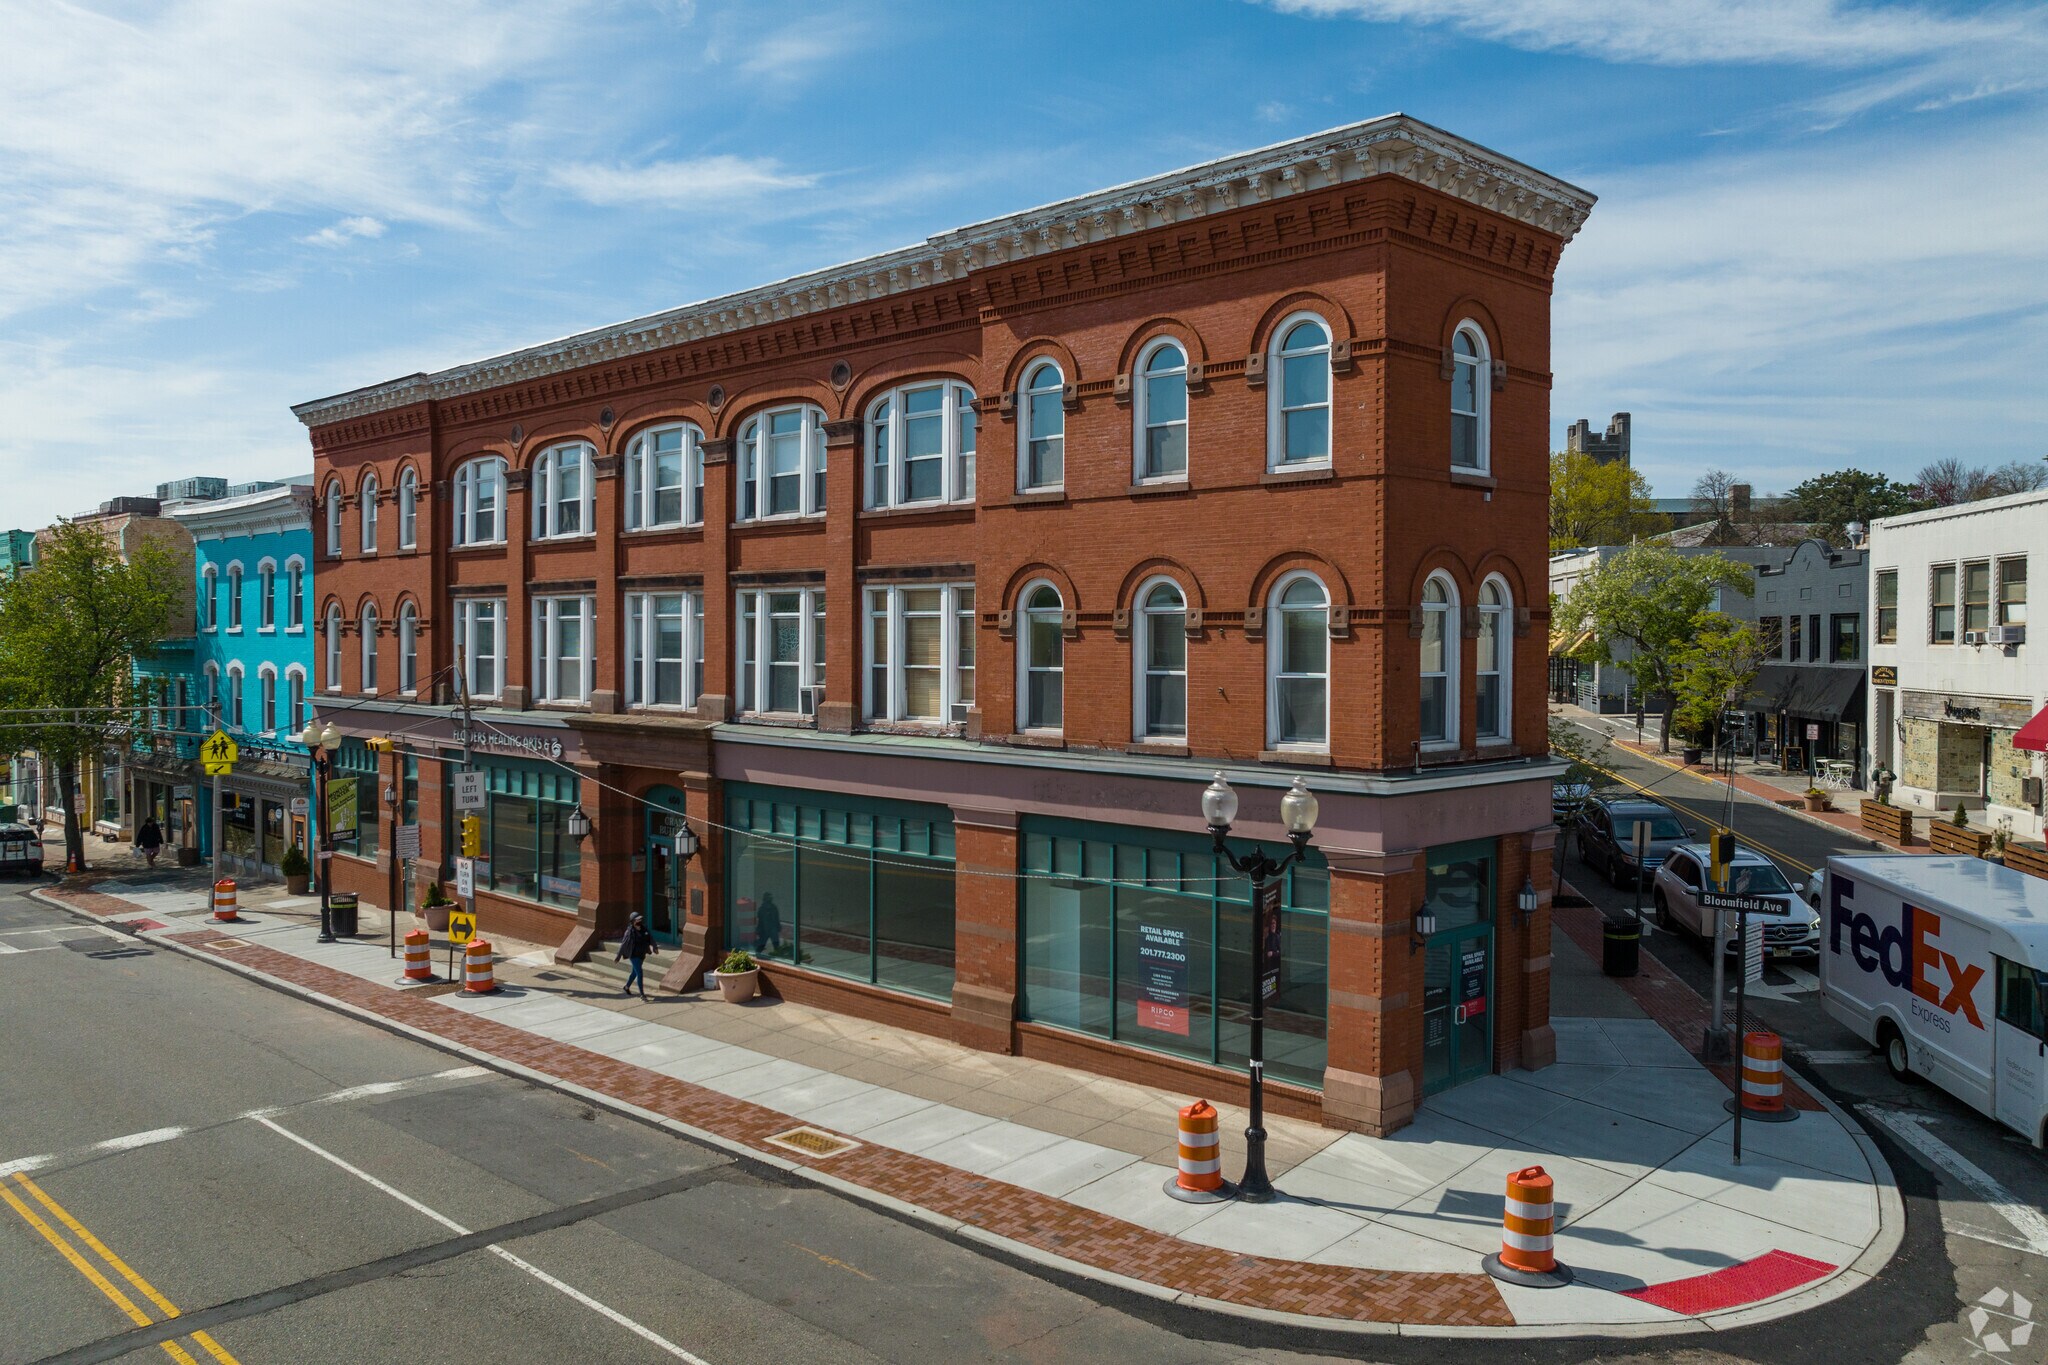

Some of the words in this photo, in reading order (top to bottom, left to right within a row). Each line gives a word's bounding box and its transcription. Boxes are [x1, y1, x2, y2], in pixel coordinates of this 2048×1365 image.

[453, 730, 486, 745] FLOERS
[488, 732, 521, 747] HEALING
[523, 735, 542, 751] ARTS
[465, 775, 475, 783] NO
[462, 785, 477, 794] LEFT
[462, 795, 479, 803] TURN
[664, 816, 684, 827] CRAN
[461, 862, 468, 870] NO
[460, 870, 469, 878] TURN
[461, 886, 469, 894] RED
[1704, 895, 1759, 910] Bloomfield
[1763, 901, 1782, 912] Ave
[1140, 925, 1162, 936] RETAIL
[1162, 929, 1184, 939] SPACE
[1145, 934, 1180, 946] AVAILABLE
[1140, 947, 1186, 962] 201.777.2300
[1462, 953, 1473, 961] RETAIL
[1474, 950, 1485, 958] SPACE
[1830, 873, 1985, 1031] FedEx
[1464, 956, 1483, 966] AVAILABLE
[1151, 1006, 1174, 1017] RIPCO
[1911, 998, 1950, 1033] Express
